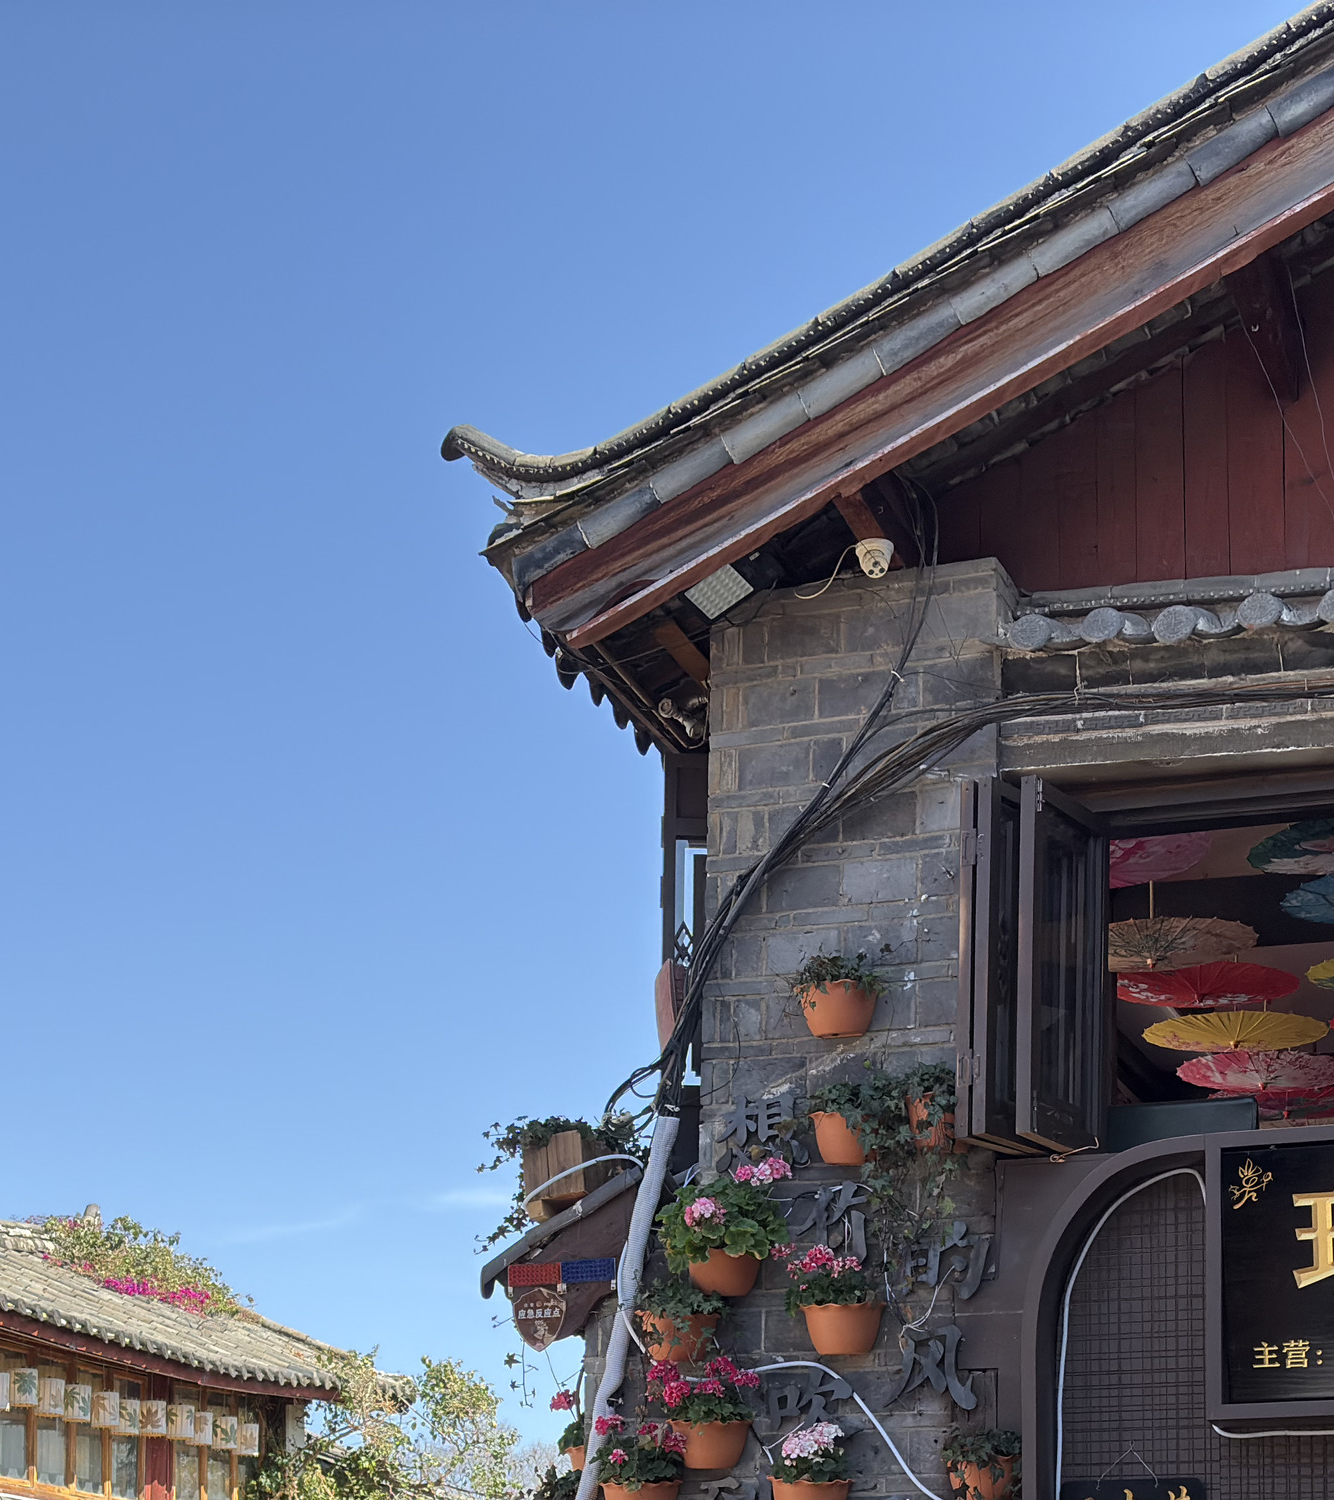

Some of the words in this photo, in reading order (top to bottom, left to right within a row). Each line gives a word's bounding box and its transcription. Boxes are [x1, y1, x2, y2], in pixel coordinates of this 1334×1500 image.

[518, 1307, 561, 1319] 应急反应点
